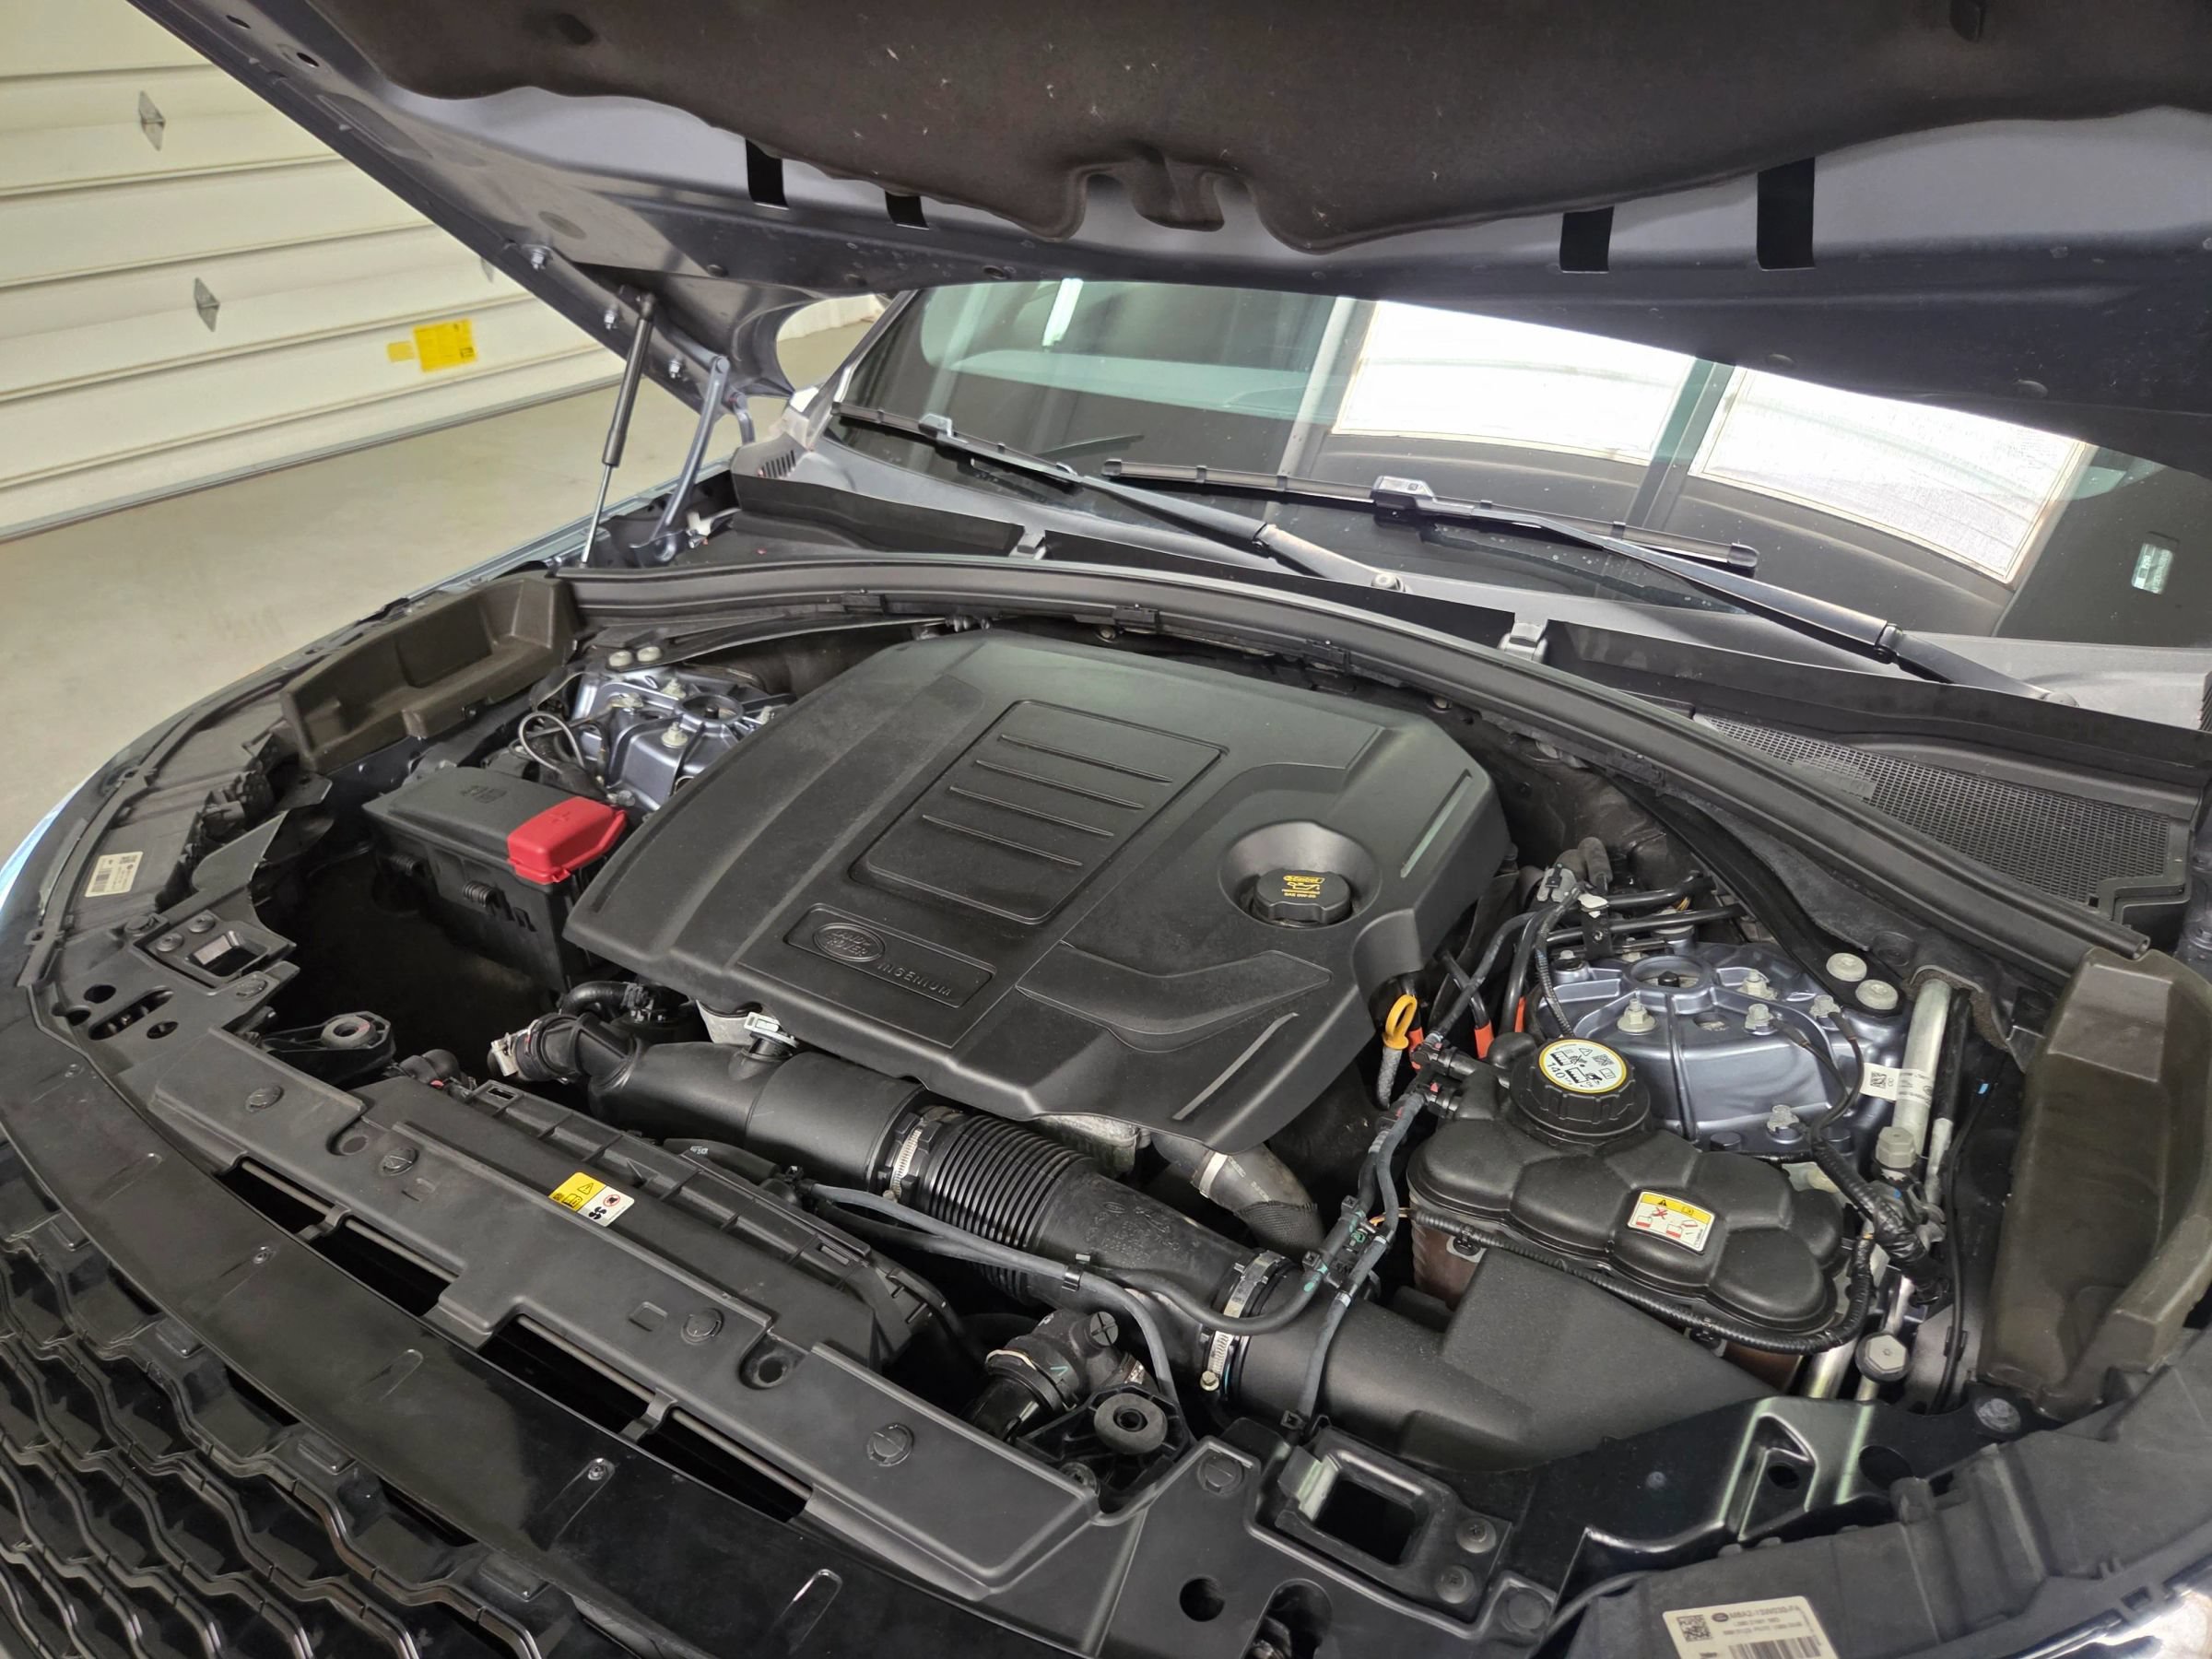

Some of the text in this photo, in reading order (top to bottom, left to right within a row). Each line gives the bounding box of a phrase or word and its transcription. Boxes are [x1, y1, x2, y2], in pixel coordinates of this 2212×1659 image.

[830, 930, 865, 945] LAND
[826, 938, 868, 957] ROVER
[877, 961, 952, 995] INGENIUM
[1547, 1062, 1565, 1078] 140
